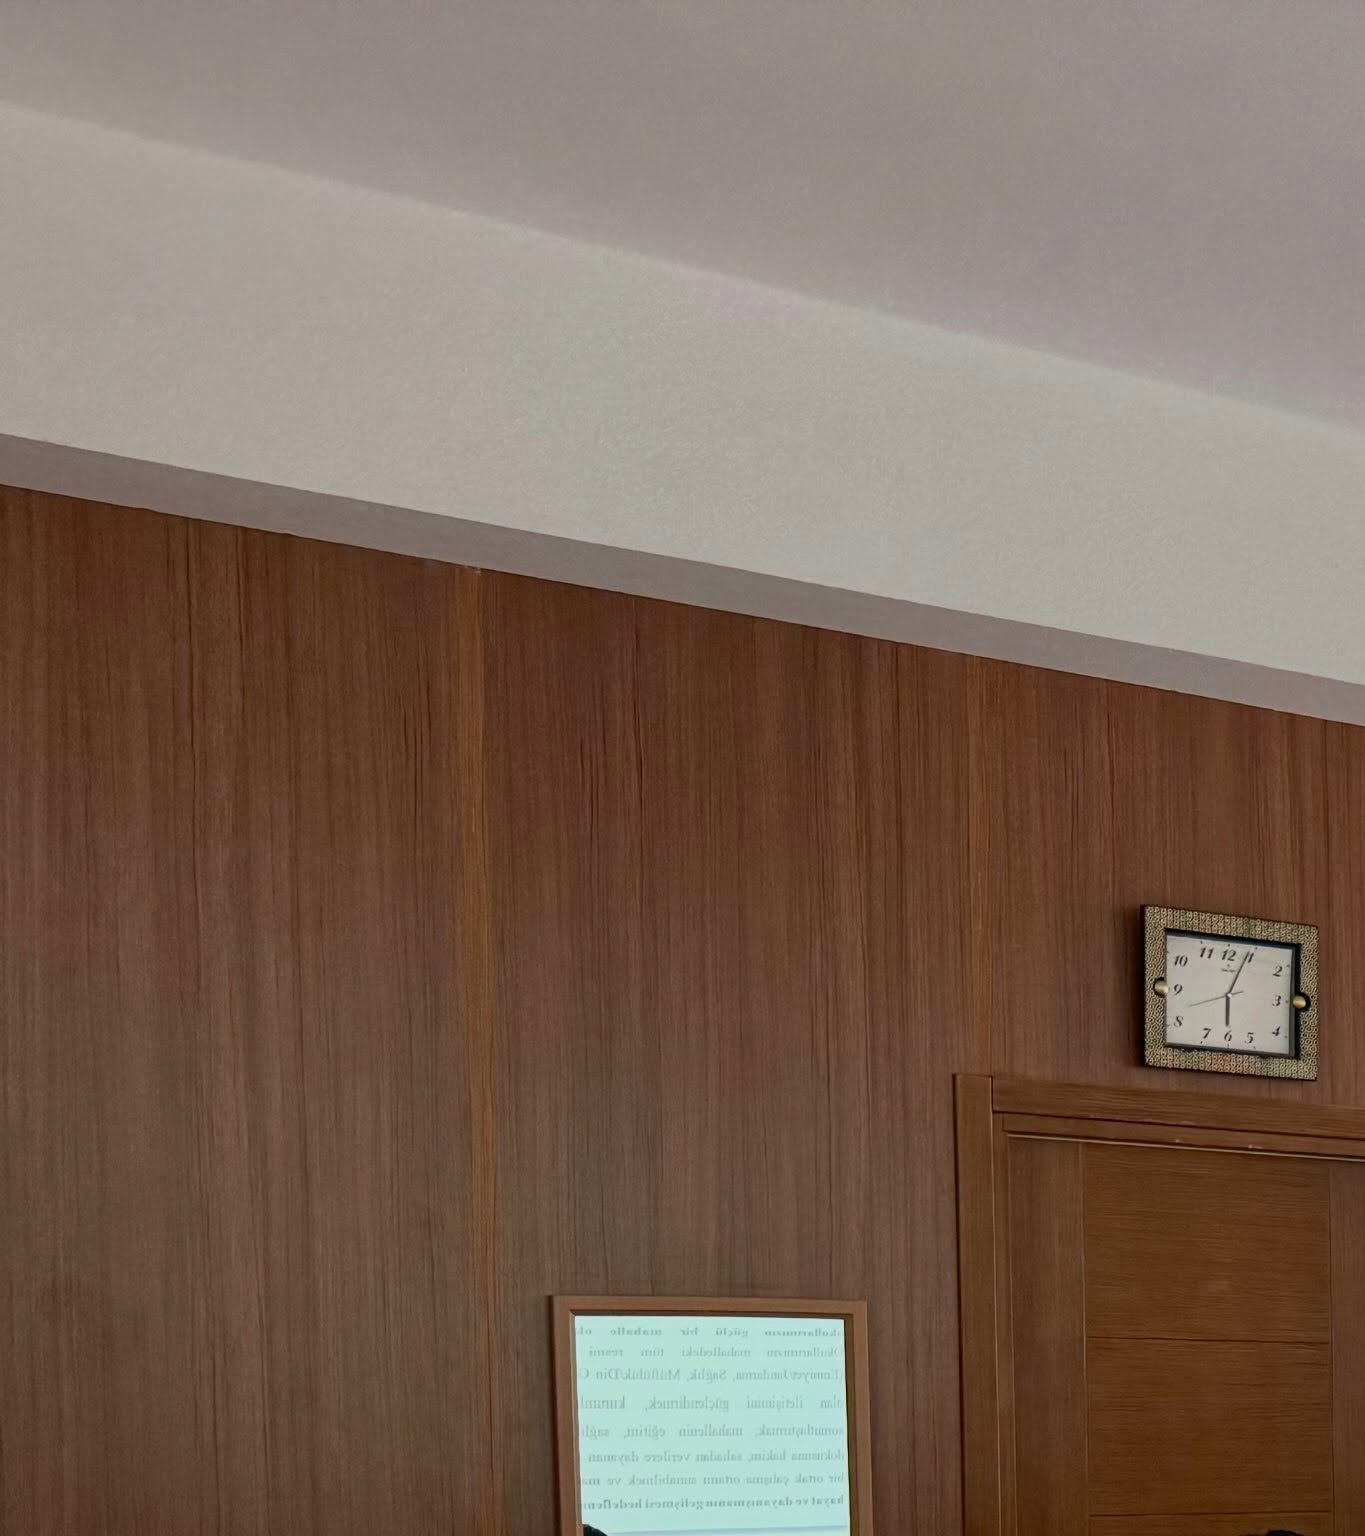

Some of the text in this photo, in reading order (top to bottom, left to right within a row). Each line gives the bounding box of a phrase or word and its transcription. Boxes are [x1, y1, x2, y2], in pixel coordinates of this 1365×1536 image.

[1200, 947, 1214, 958] 11
[1221, 949, 1236, 961] 12
[1174, 955, 1188, 967] 10
[1273, 965, 1283, 977] 2
[1174, 984, 1183, 995] 9
[1272, 995, 1281, 1007] 3
[1174, 1016, 1184, 1028] 8
[1203, 1028, 1212, 1039] 7
[1224, 1030, 1232, 1042] 6
[1272, 1026, 1281, 1036] 4
[1245, 1032, 1254, 1044] 5
